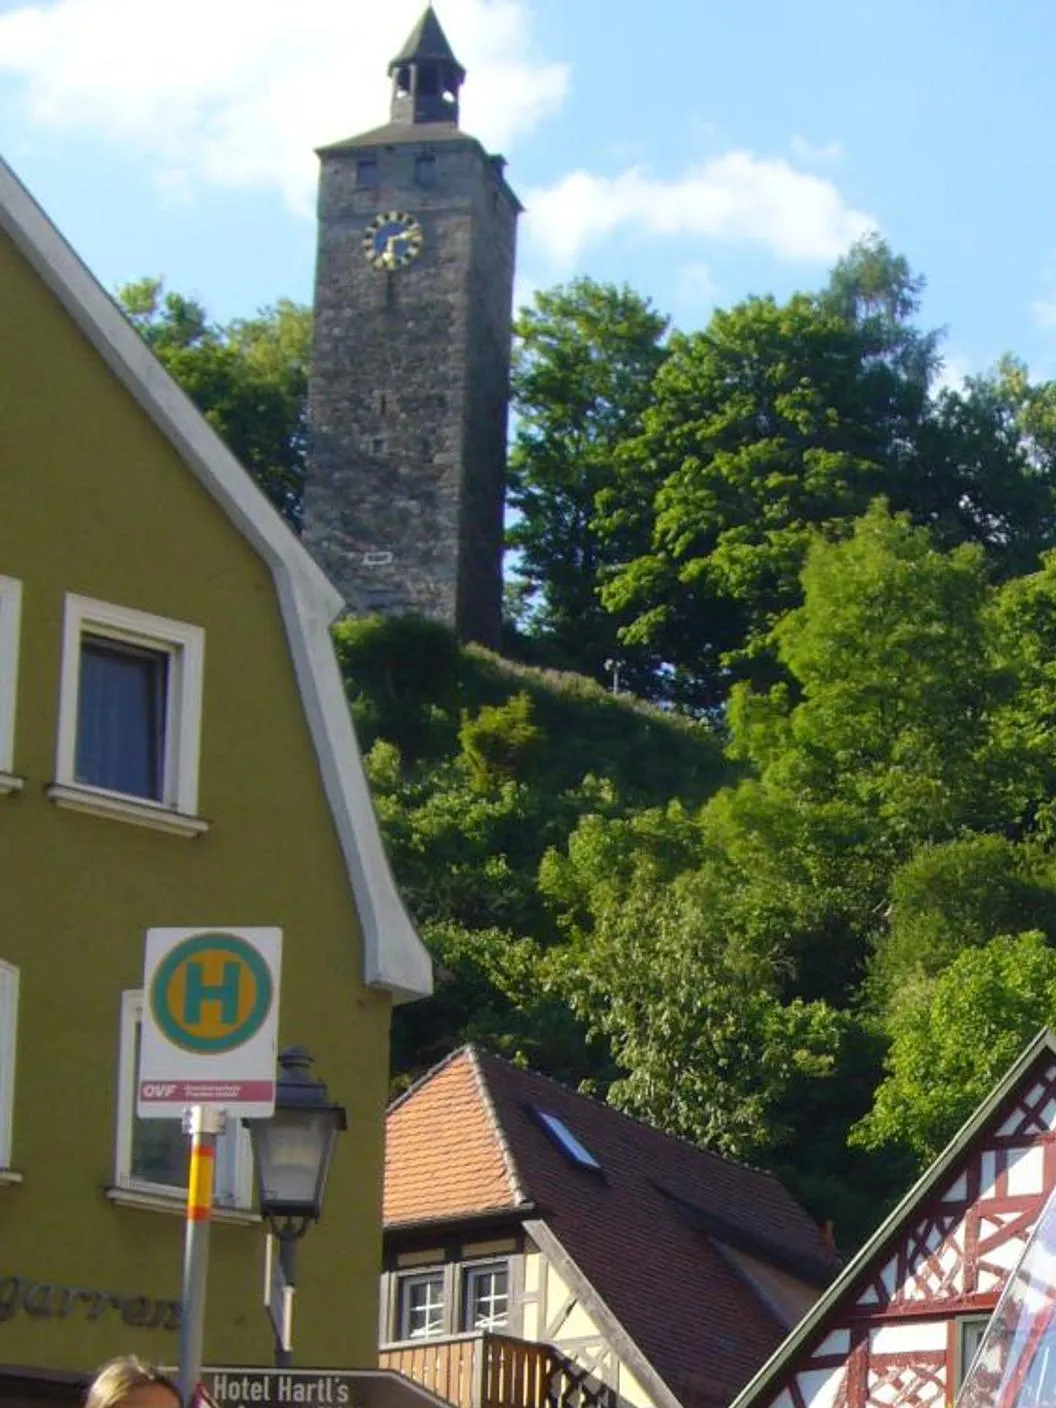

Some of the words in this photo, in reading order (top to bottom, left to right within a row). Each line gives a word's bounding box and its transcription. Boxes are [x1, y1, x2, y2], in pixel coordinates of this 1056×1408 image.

[184, 960, 241, 1025] H
[213, 1374, 270, 1401] Hotel
[278, 1375, 349, 1403] Hartl's
